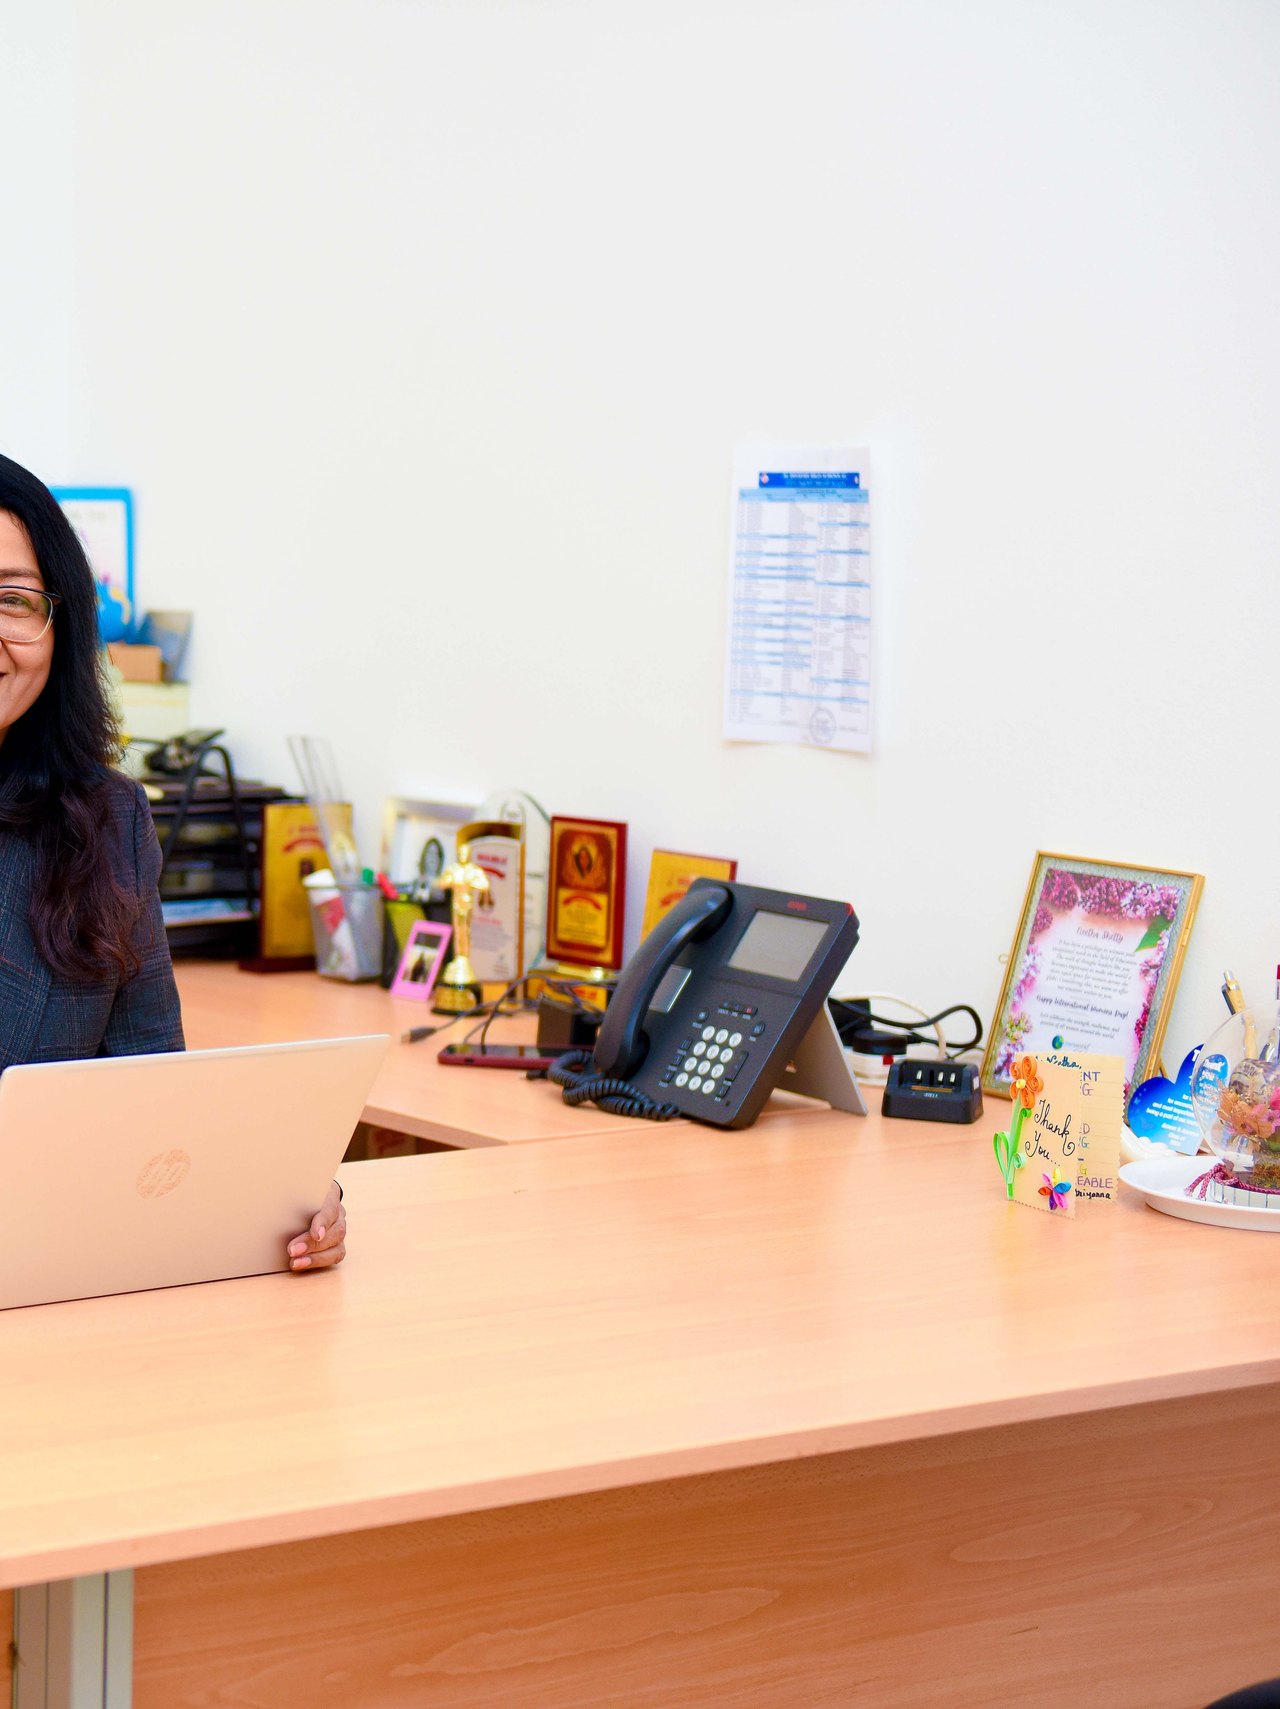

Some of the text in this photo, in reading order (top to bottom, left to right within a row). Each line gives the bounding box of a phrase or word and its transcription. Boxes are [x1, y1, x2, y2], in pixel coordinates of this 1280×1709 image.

[1036, 995, 1053, 1004] Happy
[1055, 998, 1089, 1010] International
[1034, 1099, 1076, 1157] Thank
